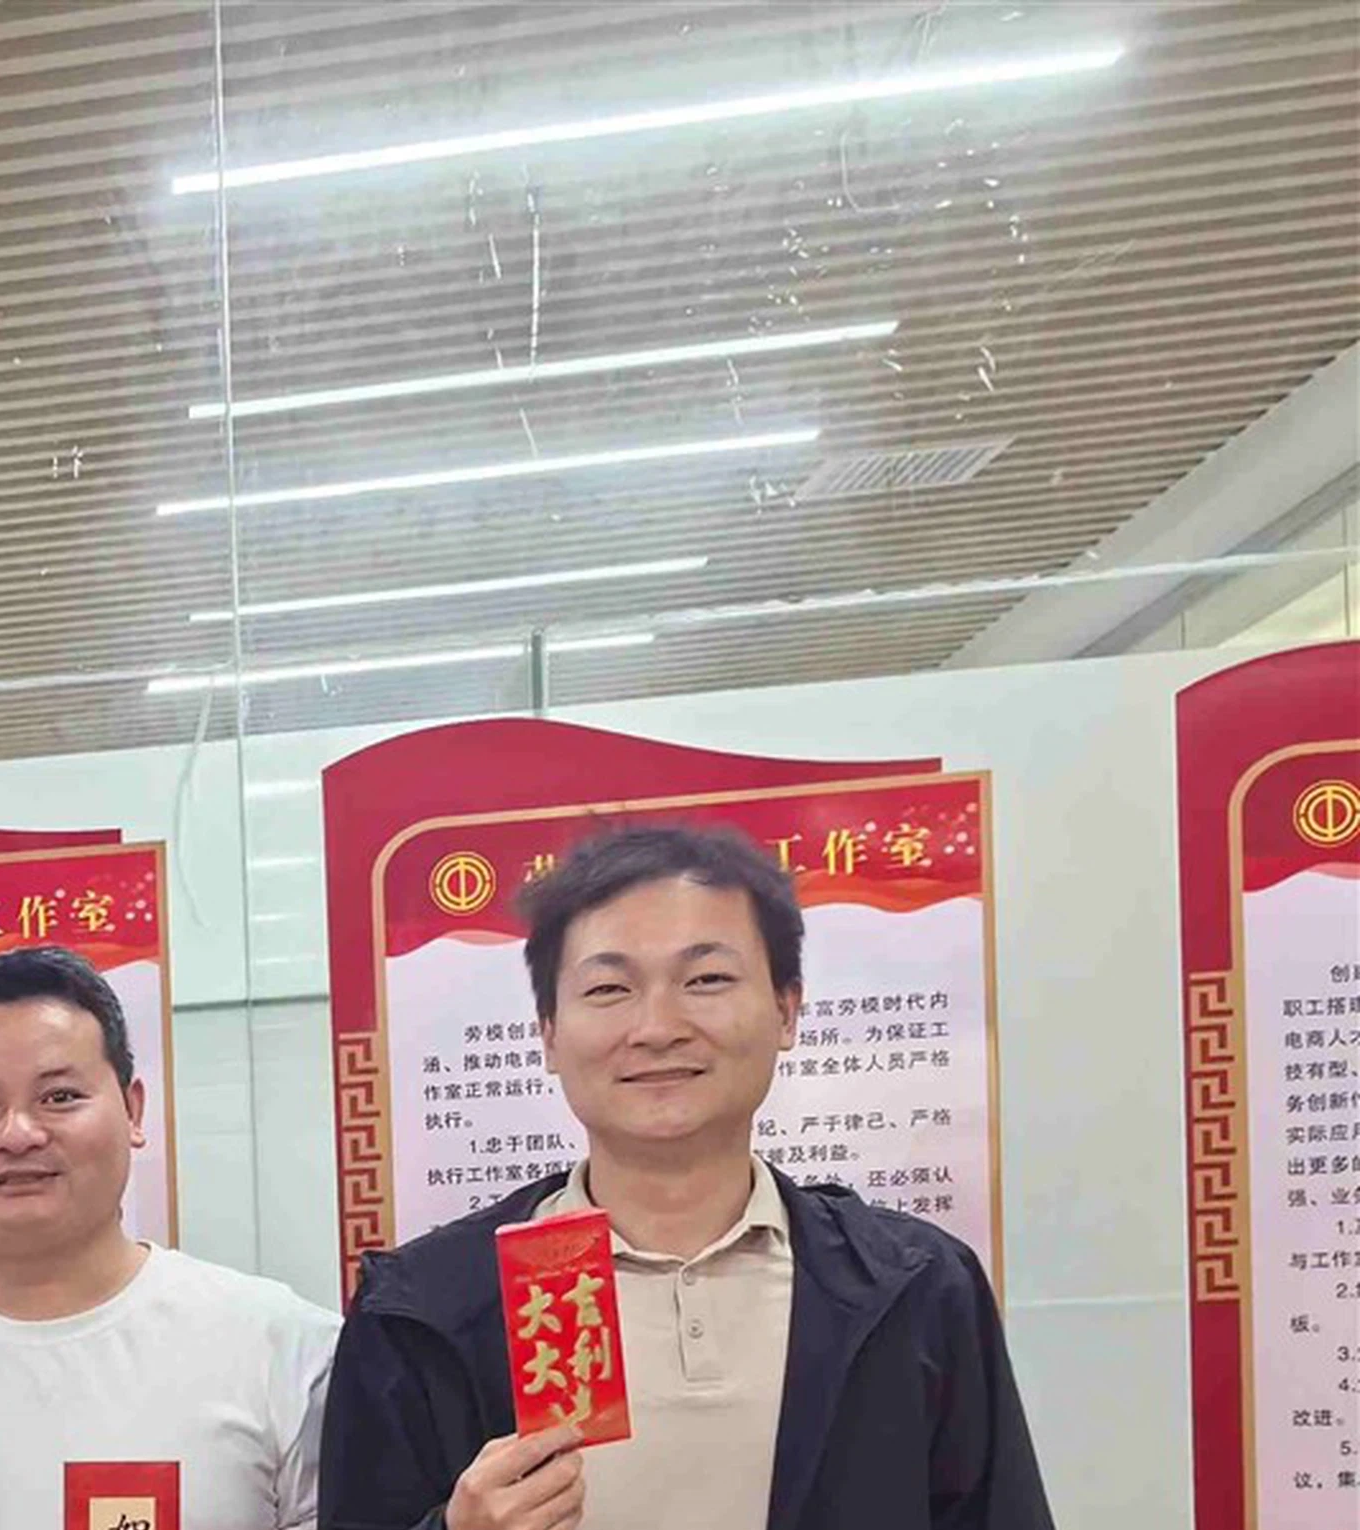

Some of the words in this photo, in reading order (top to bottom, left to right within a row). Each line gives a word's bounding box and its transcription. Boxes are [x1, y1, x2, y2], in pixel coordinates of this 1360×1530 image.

[778, 1050, 950, 1077] 作室全体人员严格
